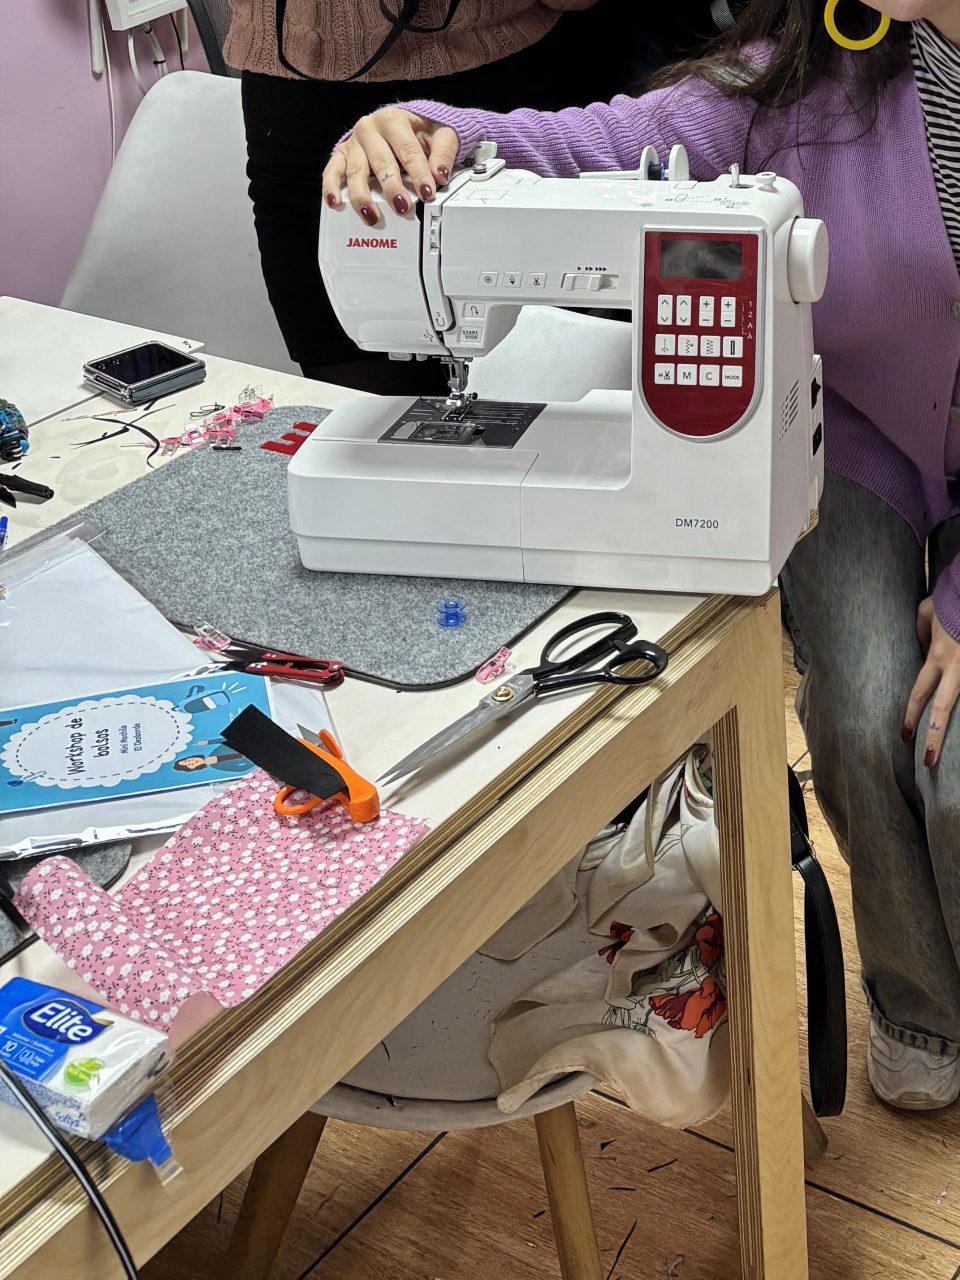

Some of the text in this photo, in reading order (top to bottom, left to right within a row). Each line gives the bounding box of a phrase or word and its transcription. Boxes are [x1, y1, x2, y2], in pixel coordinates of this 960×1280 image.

[346, 238, 398, 248] JANOME
[682, 371, 692, 380] M
[705, 372, 713, 380] C
[675, 518, 719, 529] DM7200
[64, 717, 87, 776] Workshop de
[90, 728, 110, 757] bolsos
[30, 1002, 93, 1041] Elite
[3, 1040, 17, 1053] 10
